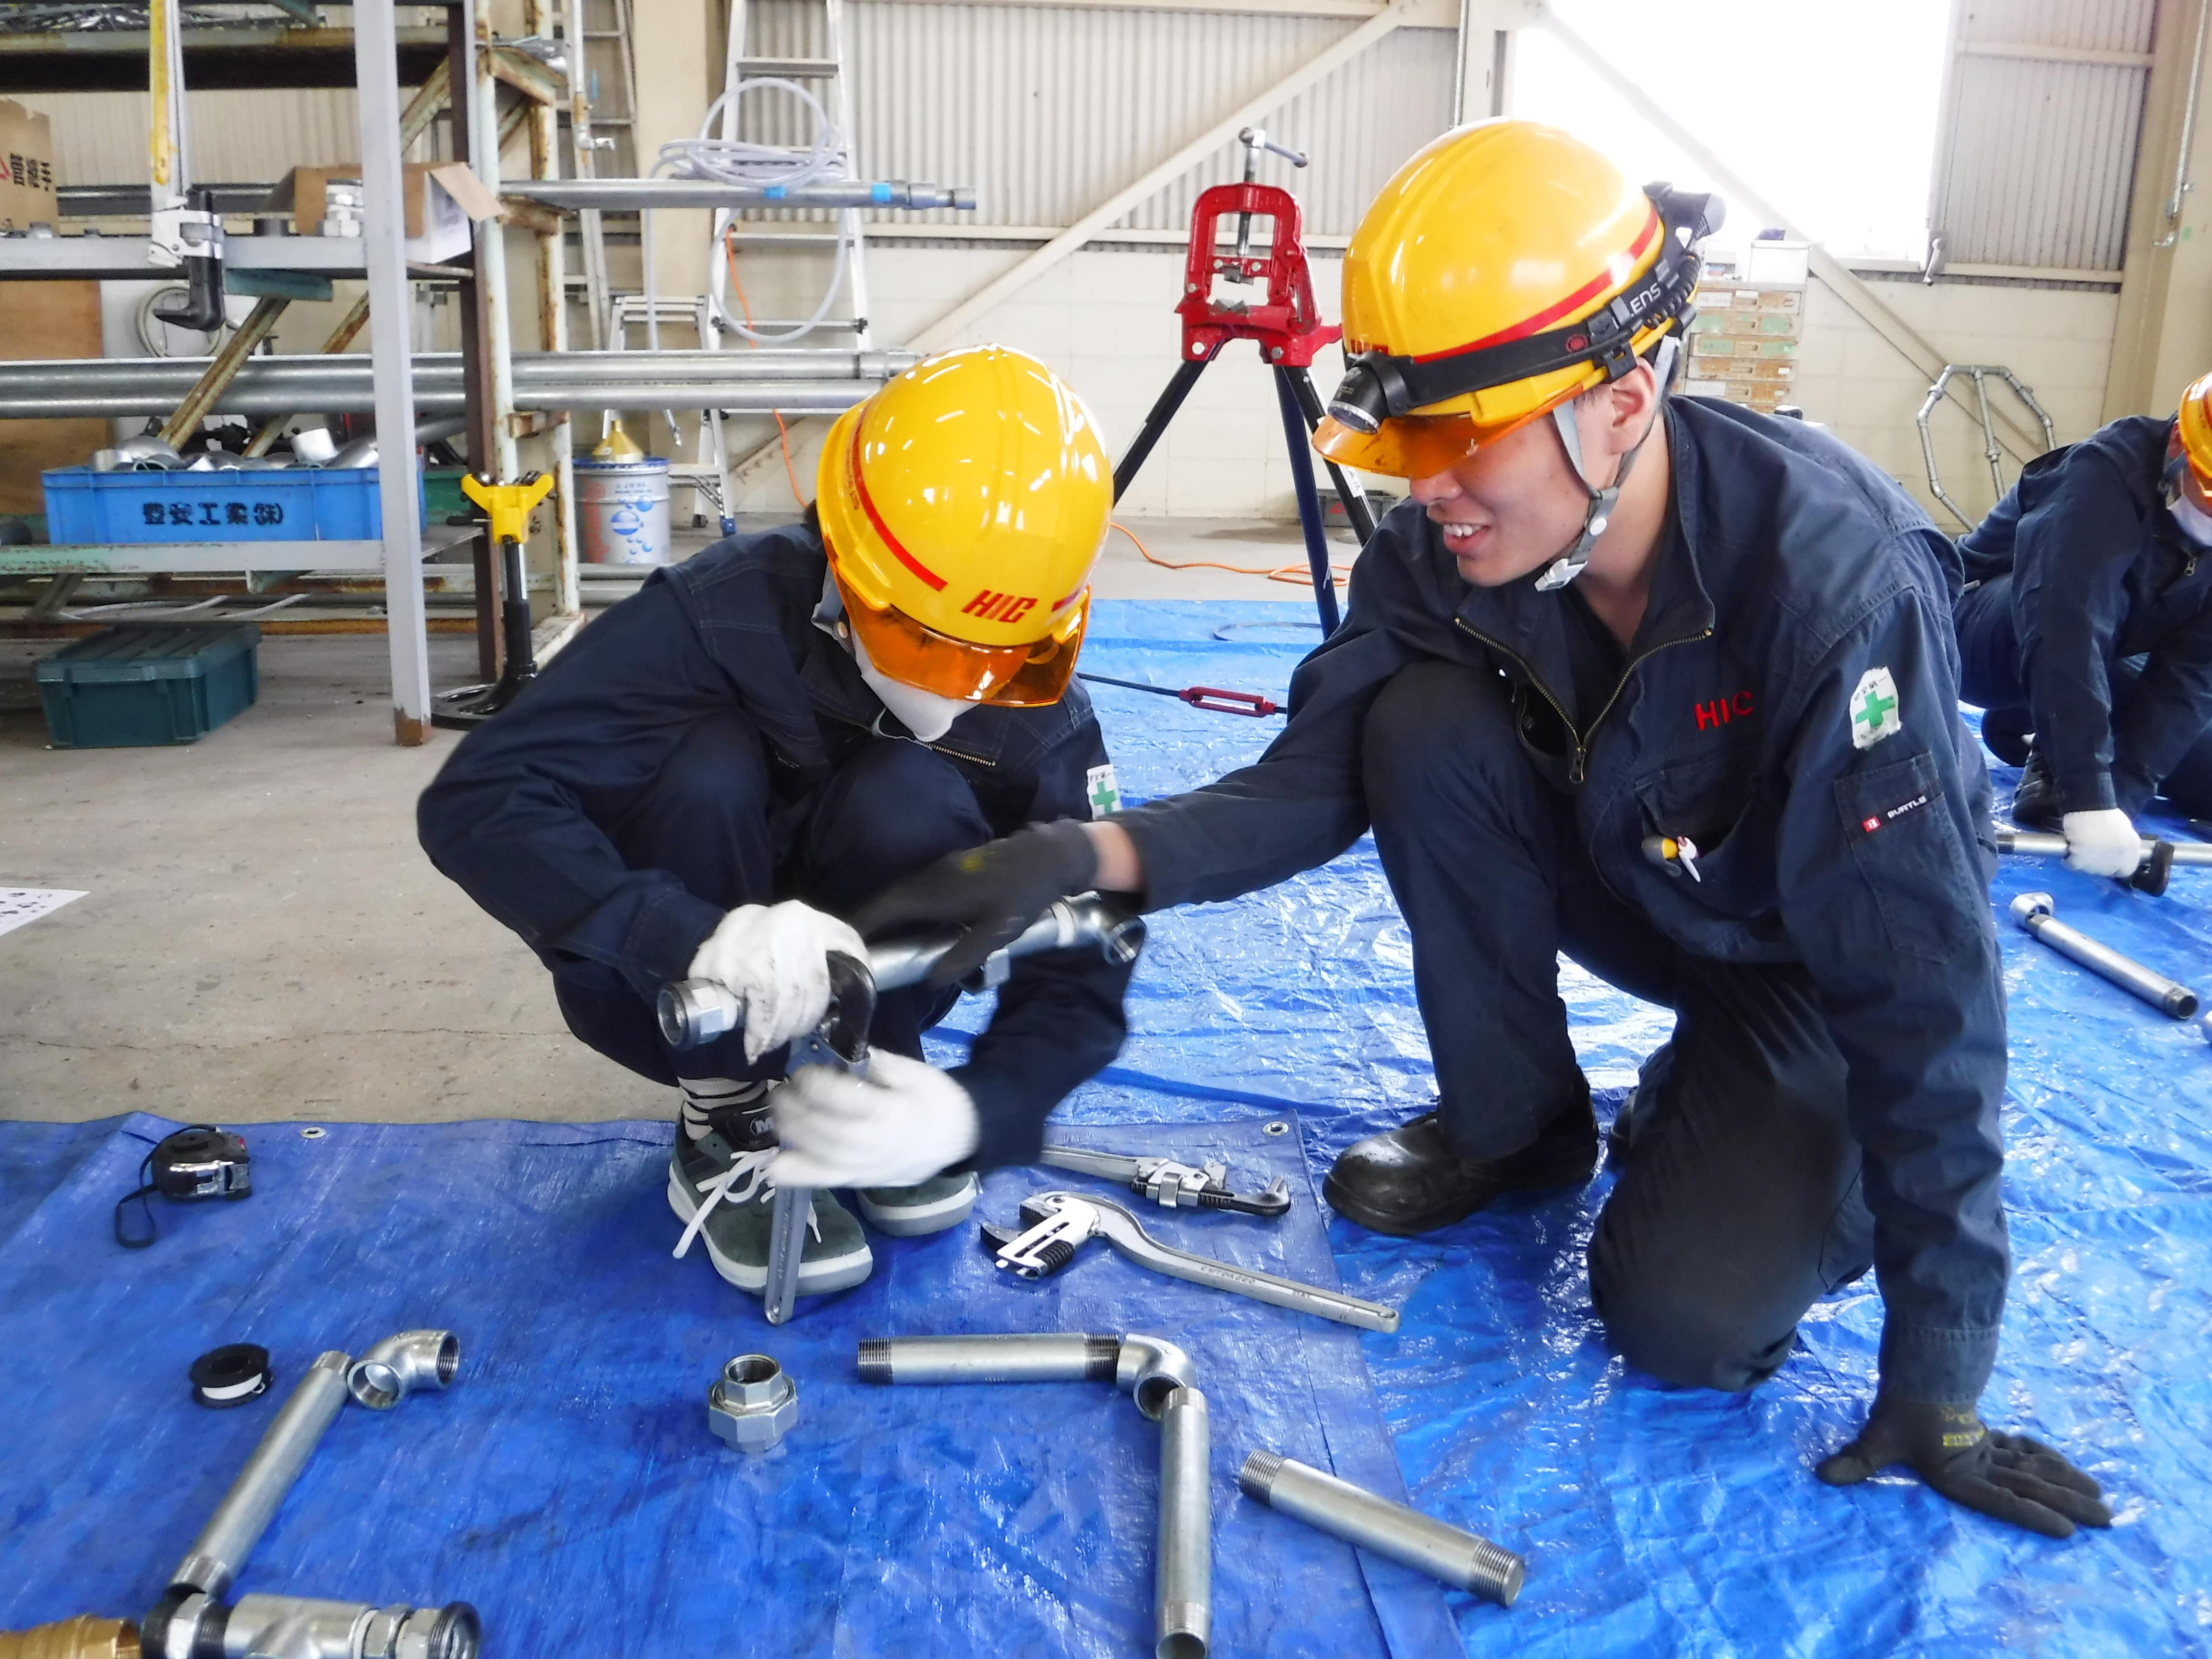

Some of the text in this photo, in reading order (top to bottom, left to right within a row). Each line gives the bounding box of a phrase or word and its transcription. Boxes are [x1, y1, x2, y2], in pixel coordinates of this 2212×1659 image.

[961, 589, 1038, 623] HIC
[1694, 690, 1755, 731] HIC
[1887, 795, 1927, 819] BURTLE
